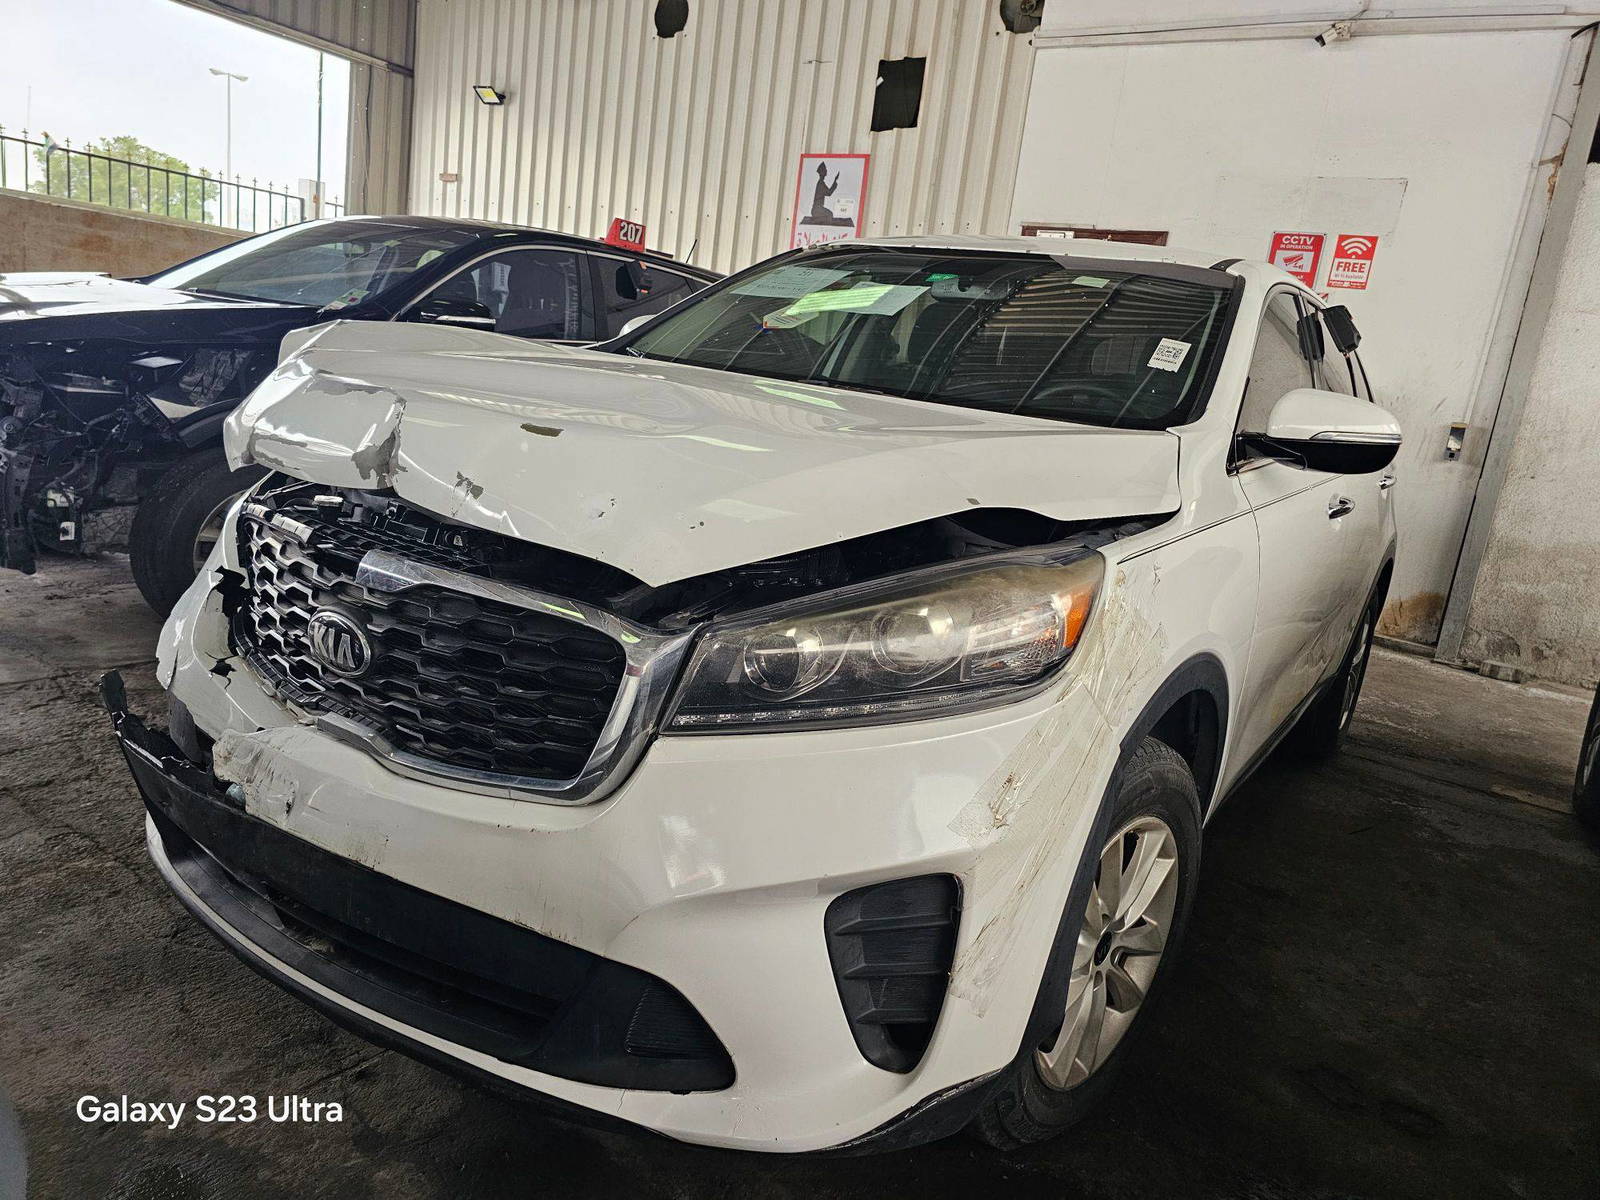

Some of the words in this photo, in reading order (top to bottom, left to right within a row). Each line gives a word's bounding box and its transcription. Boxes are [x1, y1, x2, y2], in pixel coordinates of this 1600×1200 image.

[620, 221, 643, 244] 207
[1282, 235, 1315, 245] CCTV
[1336, 261, 1367, 273] FREE
[312, 621, 356, 668] KIA
